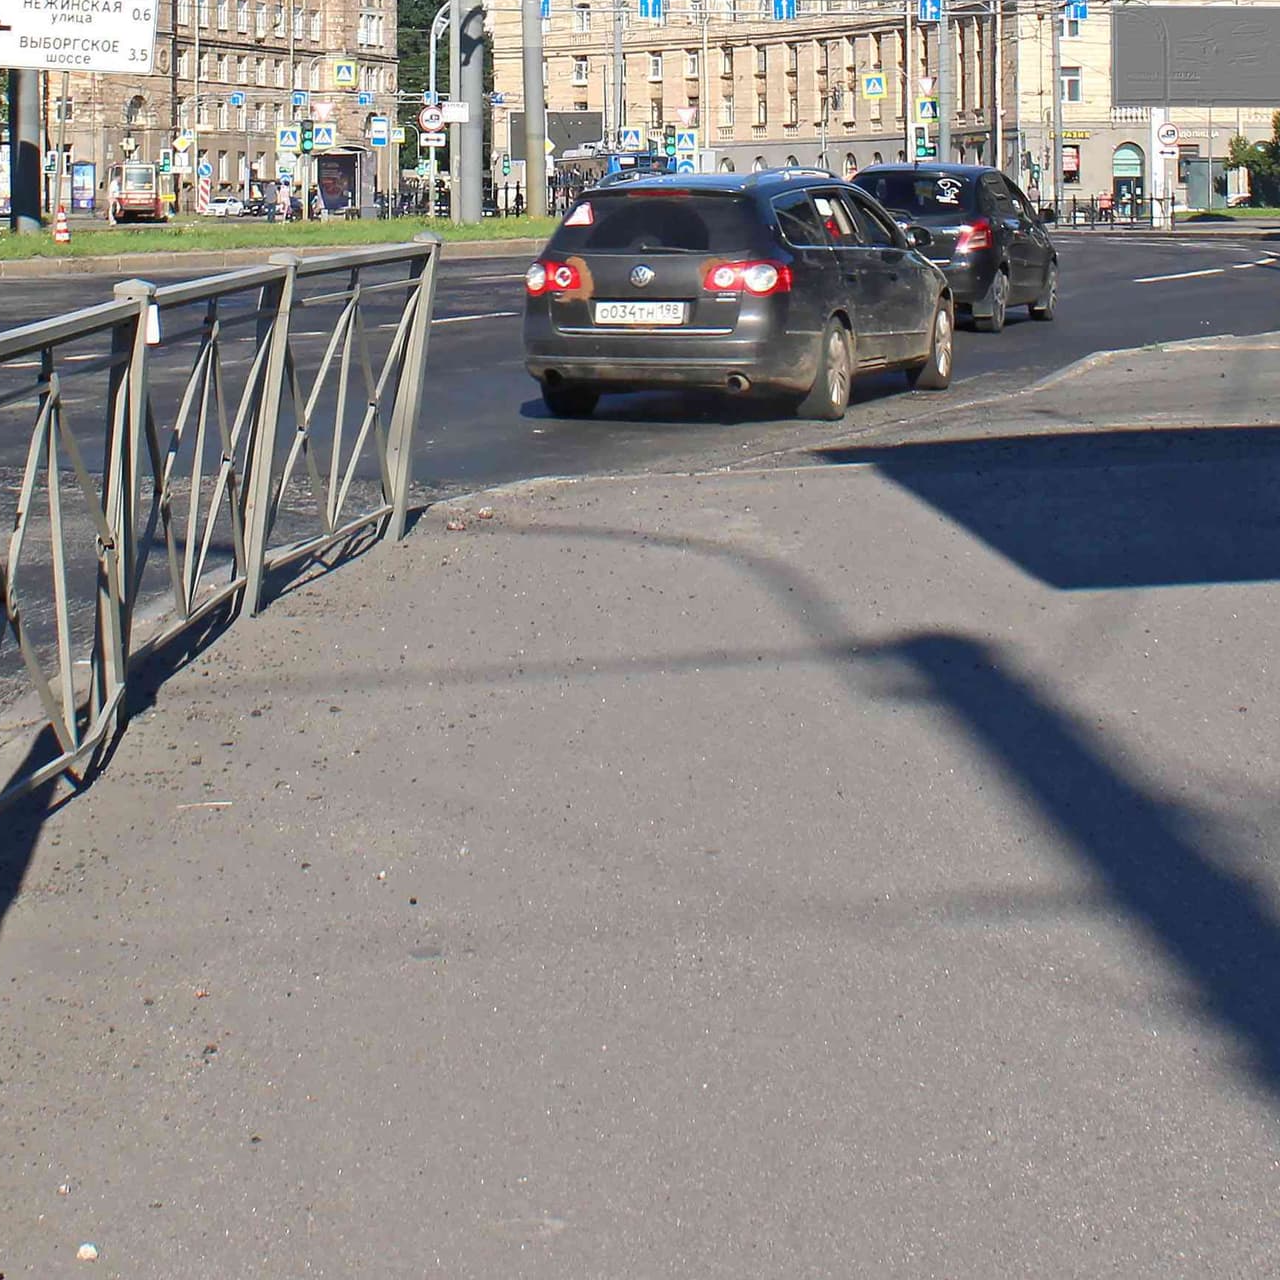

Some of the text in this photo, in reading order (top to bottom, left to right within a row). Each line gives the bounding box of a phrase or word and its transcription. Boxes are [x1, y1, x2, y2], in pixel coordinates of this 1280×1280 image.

[51, 12, 93, 25] улица
[131, 8, 152, 22] 0.6
[19, 35, 149, 62] ВЫБОРГСКОЕ 3.5
[46, 53, 92, 65] шоссе
